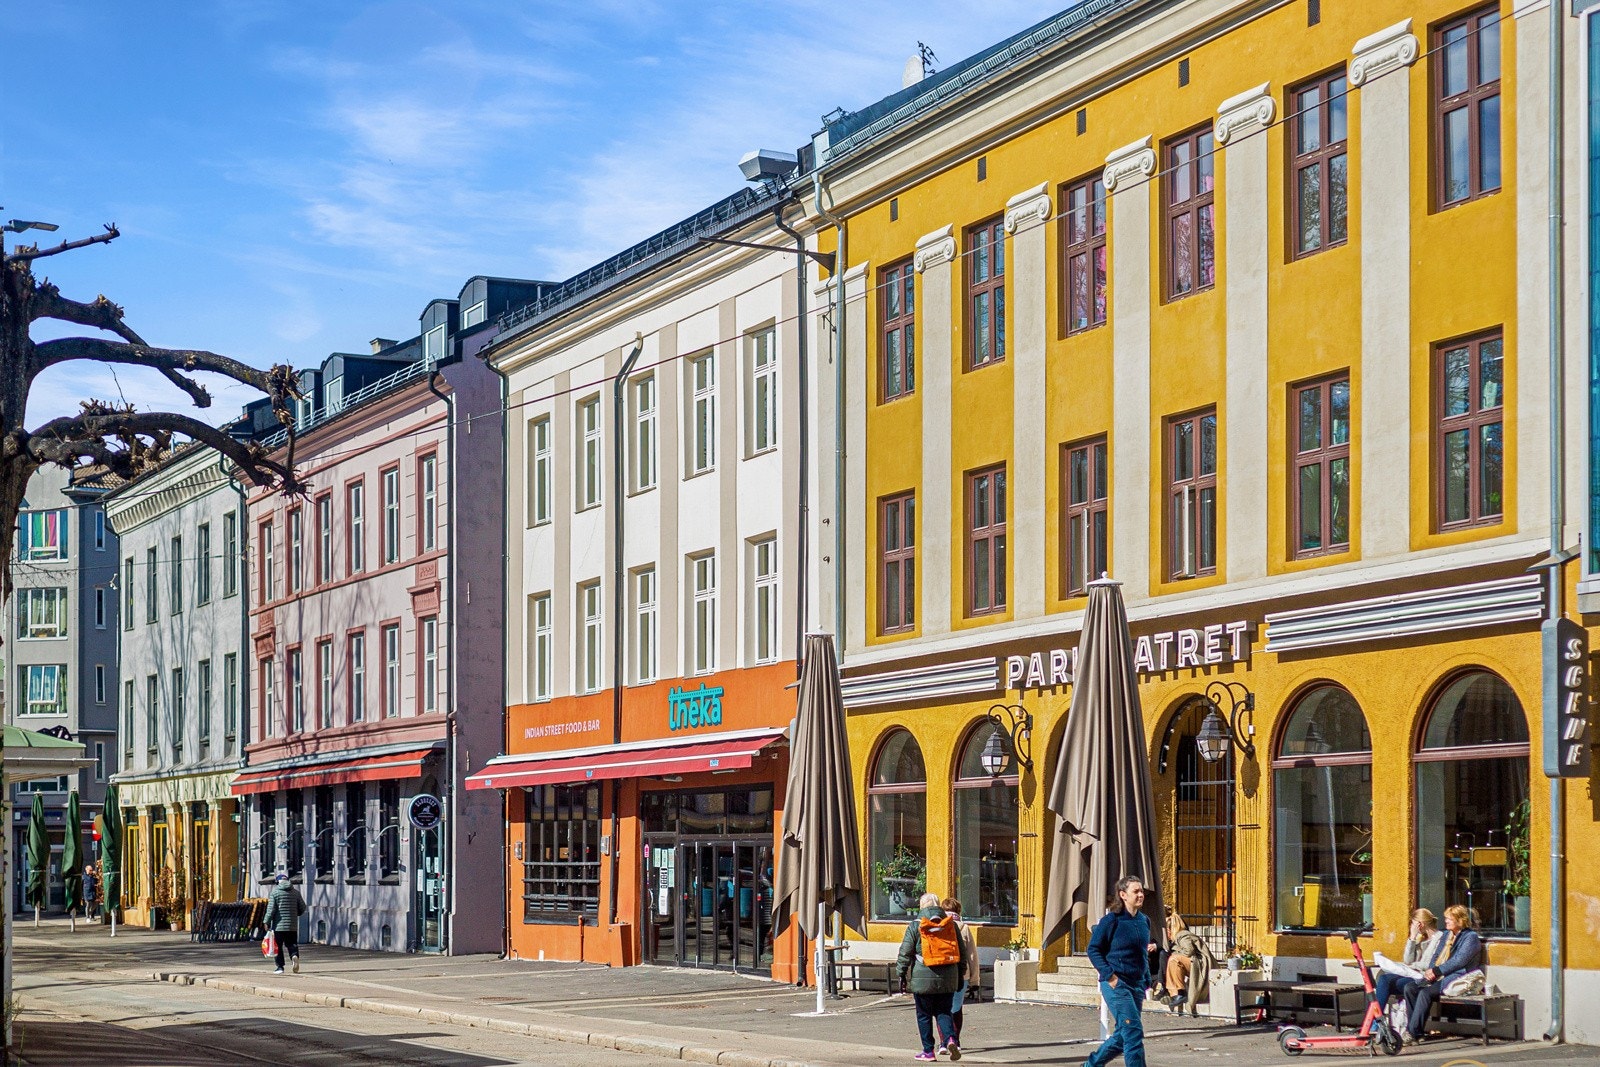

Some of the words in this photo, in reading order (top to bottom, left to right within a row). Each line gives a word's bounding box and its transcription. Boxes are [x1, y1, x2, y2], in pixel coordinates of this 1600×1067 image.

[1007, 620, 1247, 690] PARATRET
[668, 682, 724, 731] theka
[1564, 638, 1586, 766] SCENE
[524, 727, 544, 738] INDIAN
[544, 724, 565, 736] STREET
[566, 722, 582, 734] FOOD
[583, 721, 587, 732] &
[588, 720, 600, 730] BAR
[130, 783, 160, 804] VILLA
